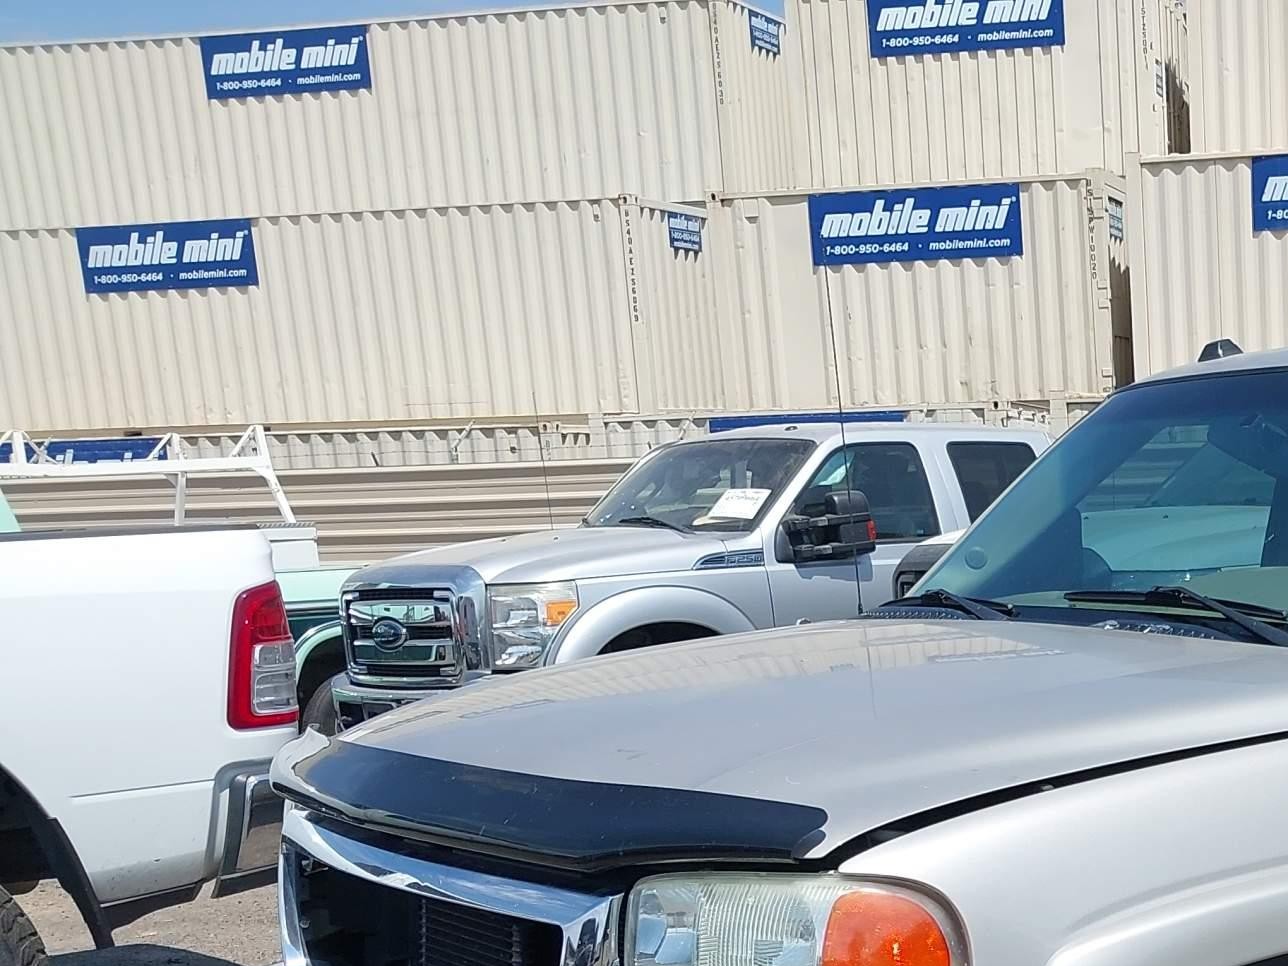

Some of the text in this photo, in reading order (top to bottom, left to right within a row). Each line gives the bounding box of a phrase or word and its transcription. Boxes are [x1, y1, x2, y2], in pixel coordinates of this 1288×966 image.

[876, 0, 1051, 31] mobile mini
[882, 28, 1053, 48] 1-800-950-6464 mobilemini.com
[210, 37, 359, 75] mobile mini
[216, 73, 361, 90] 1-800-950-6464 mobilemini.com
[820, 198, 1011, 238] mobile mini
[87, 231, 244, 268] mobile mini
[826, 238, 1010, 256] 1-800-950-6464 mobilemini.com
[94, 268, 247, 284] 1-800-950-6464 mobilemini.com
